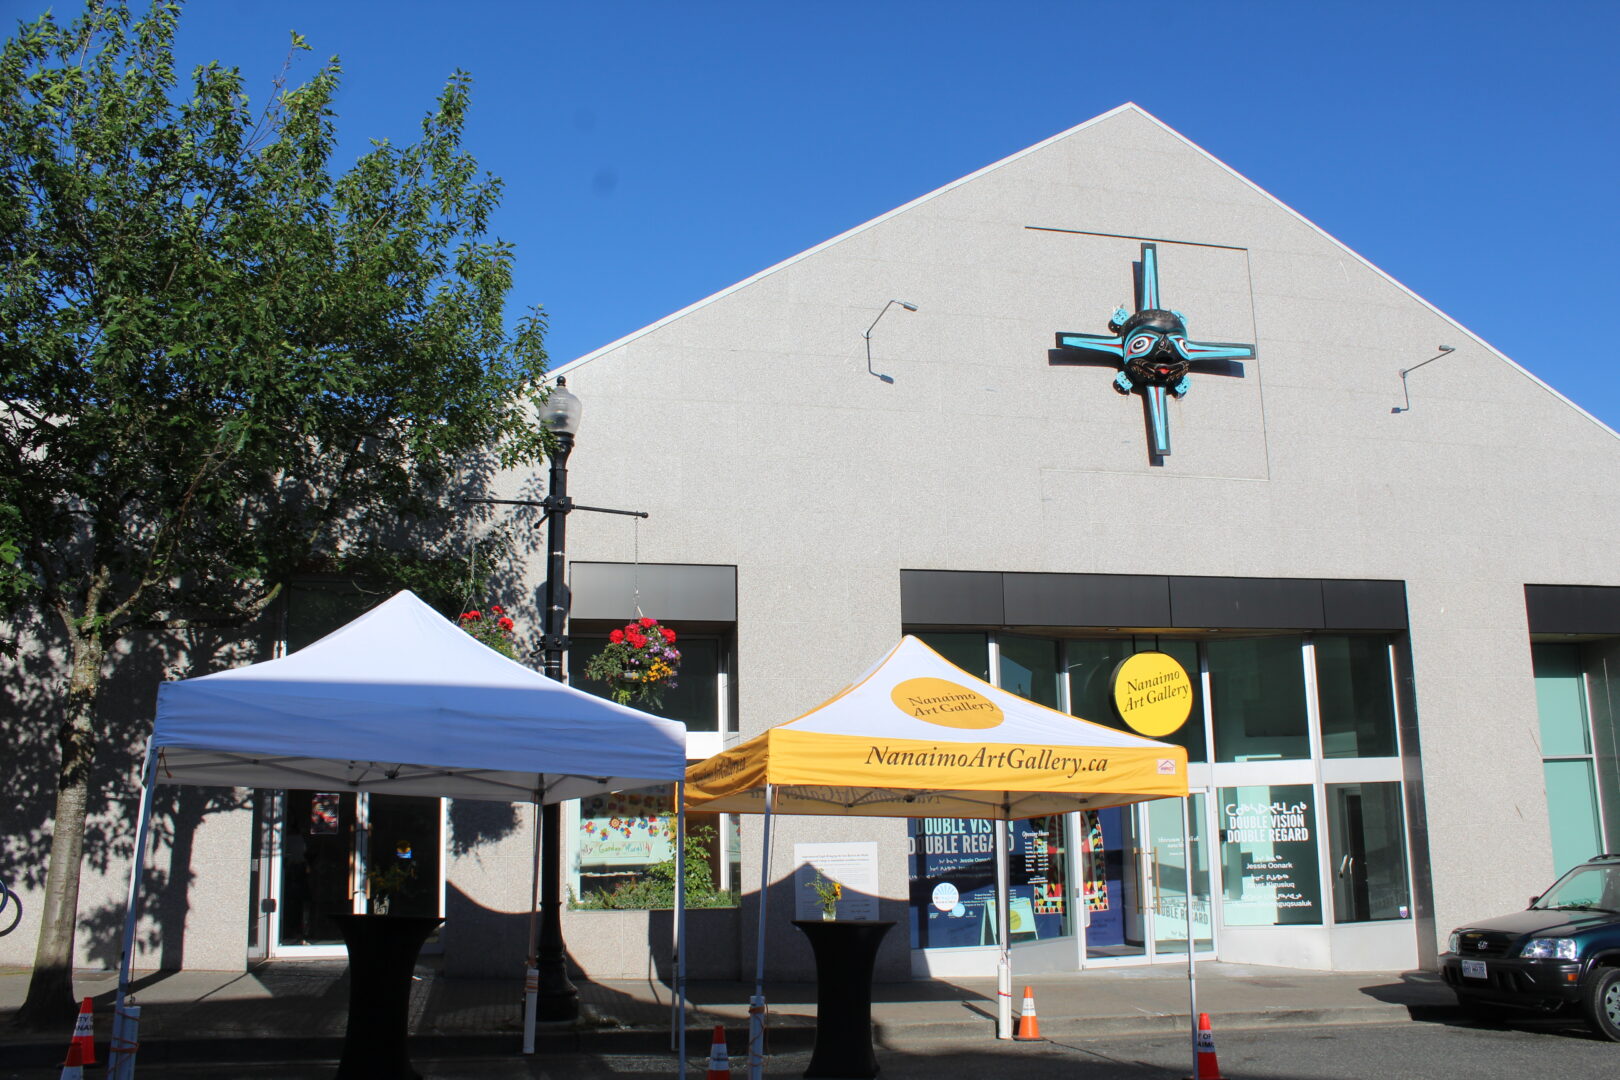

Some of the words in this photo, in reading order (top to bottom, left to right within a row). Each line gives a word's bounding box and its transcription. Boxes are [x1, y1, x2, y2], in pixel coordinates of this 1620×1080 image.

[1127, 671, 1180, 694] Nanaimo
[906, 692, 976, 706] Nanaimo
[1124, 696, 1144, 712] Art
[1146, 684, 1189, 704] Gallery
[914, 707, 938, 717] Art
[940, 702, 995, 712] Gallery
[864, 746, 1108, 778] NanaimoArtGallery.ca
[916, 818, 966, 835] DOUBLE
[1230, 816, 1267, 829] DOUBLE
[1271, 814, 1304, 828] VISION
[1227, 829, 1266, 843] DOUBLE
[1269, 828, 1309, 841] REGARD
[908, 835, 959, 855] DOUBLE
